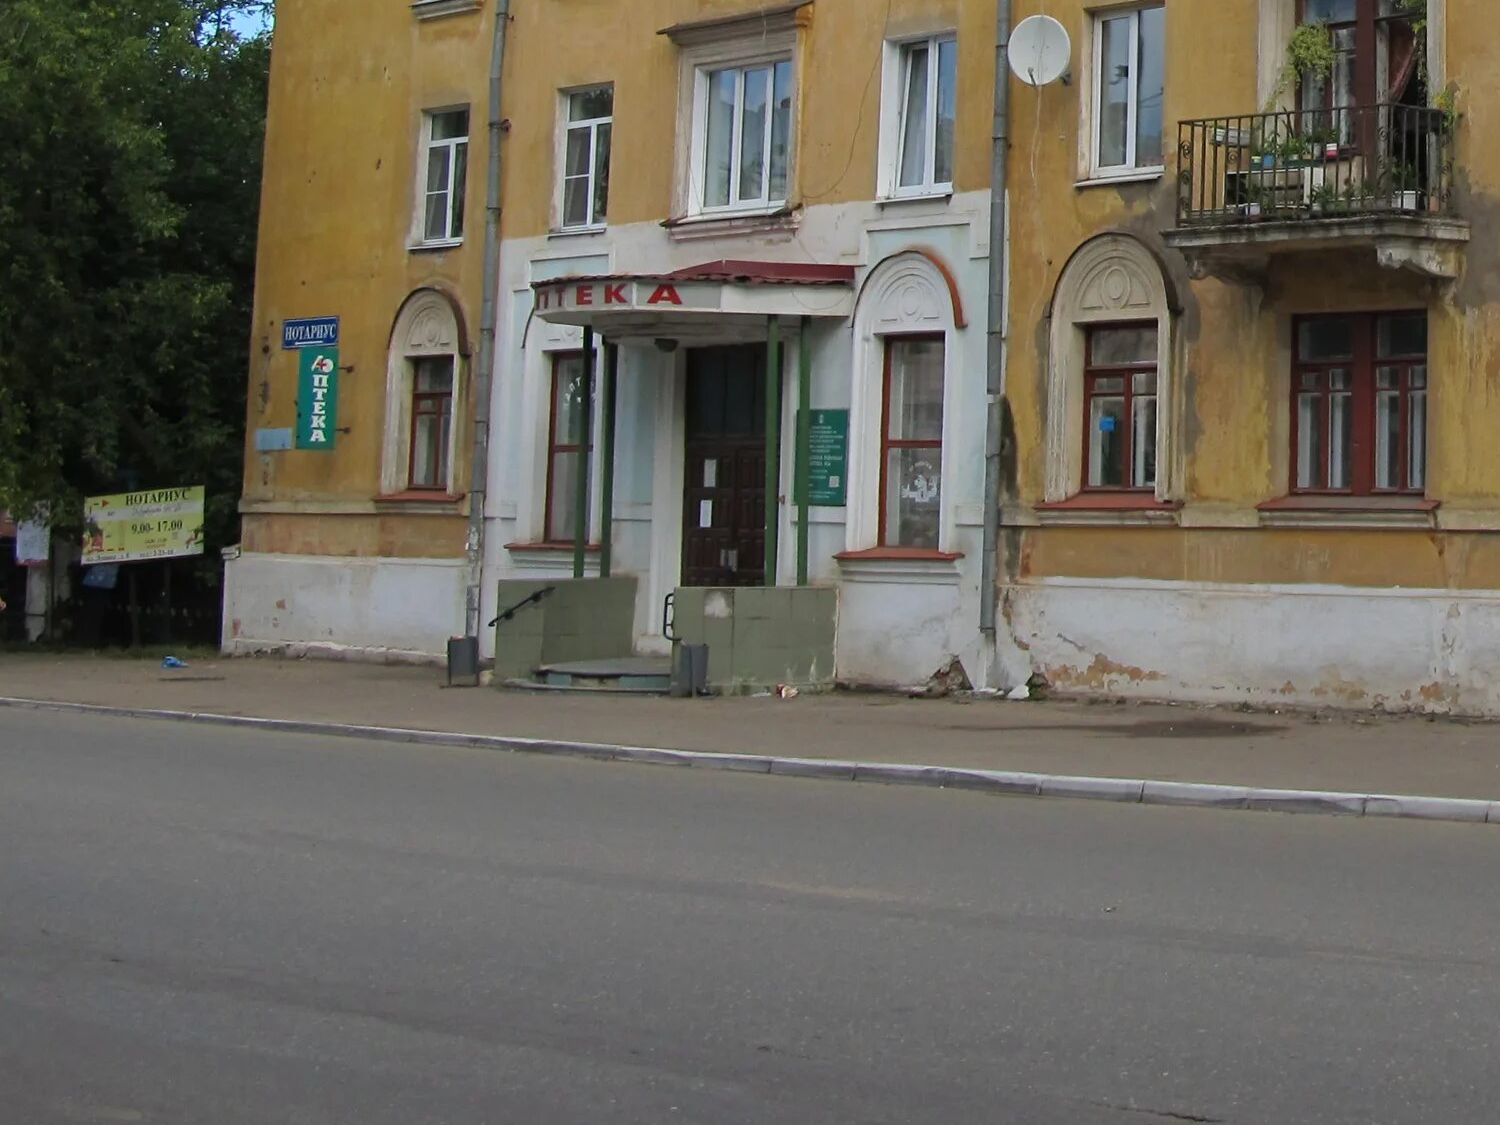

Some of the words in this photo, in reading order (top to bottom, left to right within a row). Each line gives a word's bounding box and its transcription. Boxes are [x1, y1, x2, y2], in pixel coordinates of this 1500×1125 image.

[535, 282, 682, 310] ПТЕКА
[284, 323, 337, 341] НОТАРИУС
[309, 355, 334, 442] АПТЕКА
[126, 489, 191, 506] НОТАРИУС
